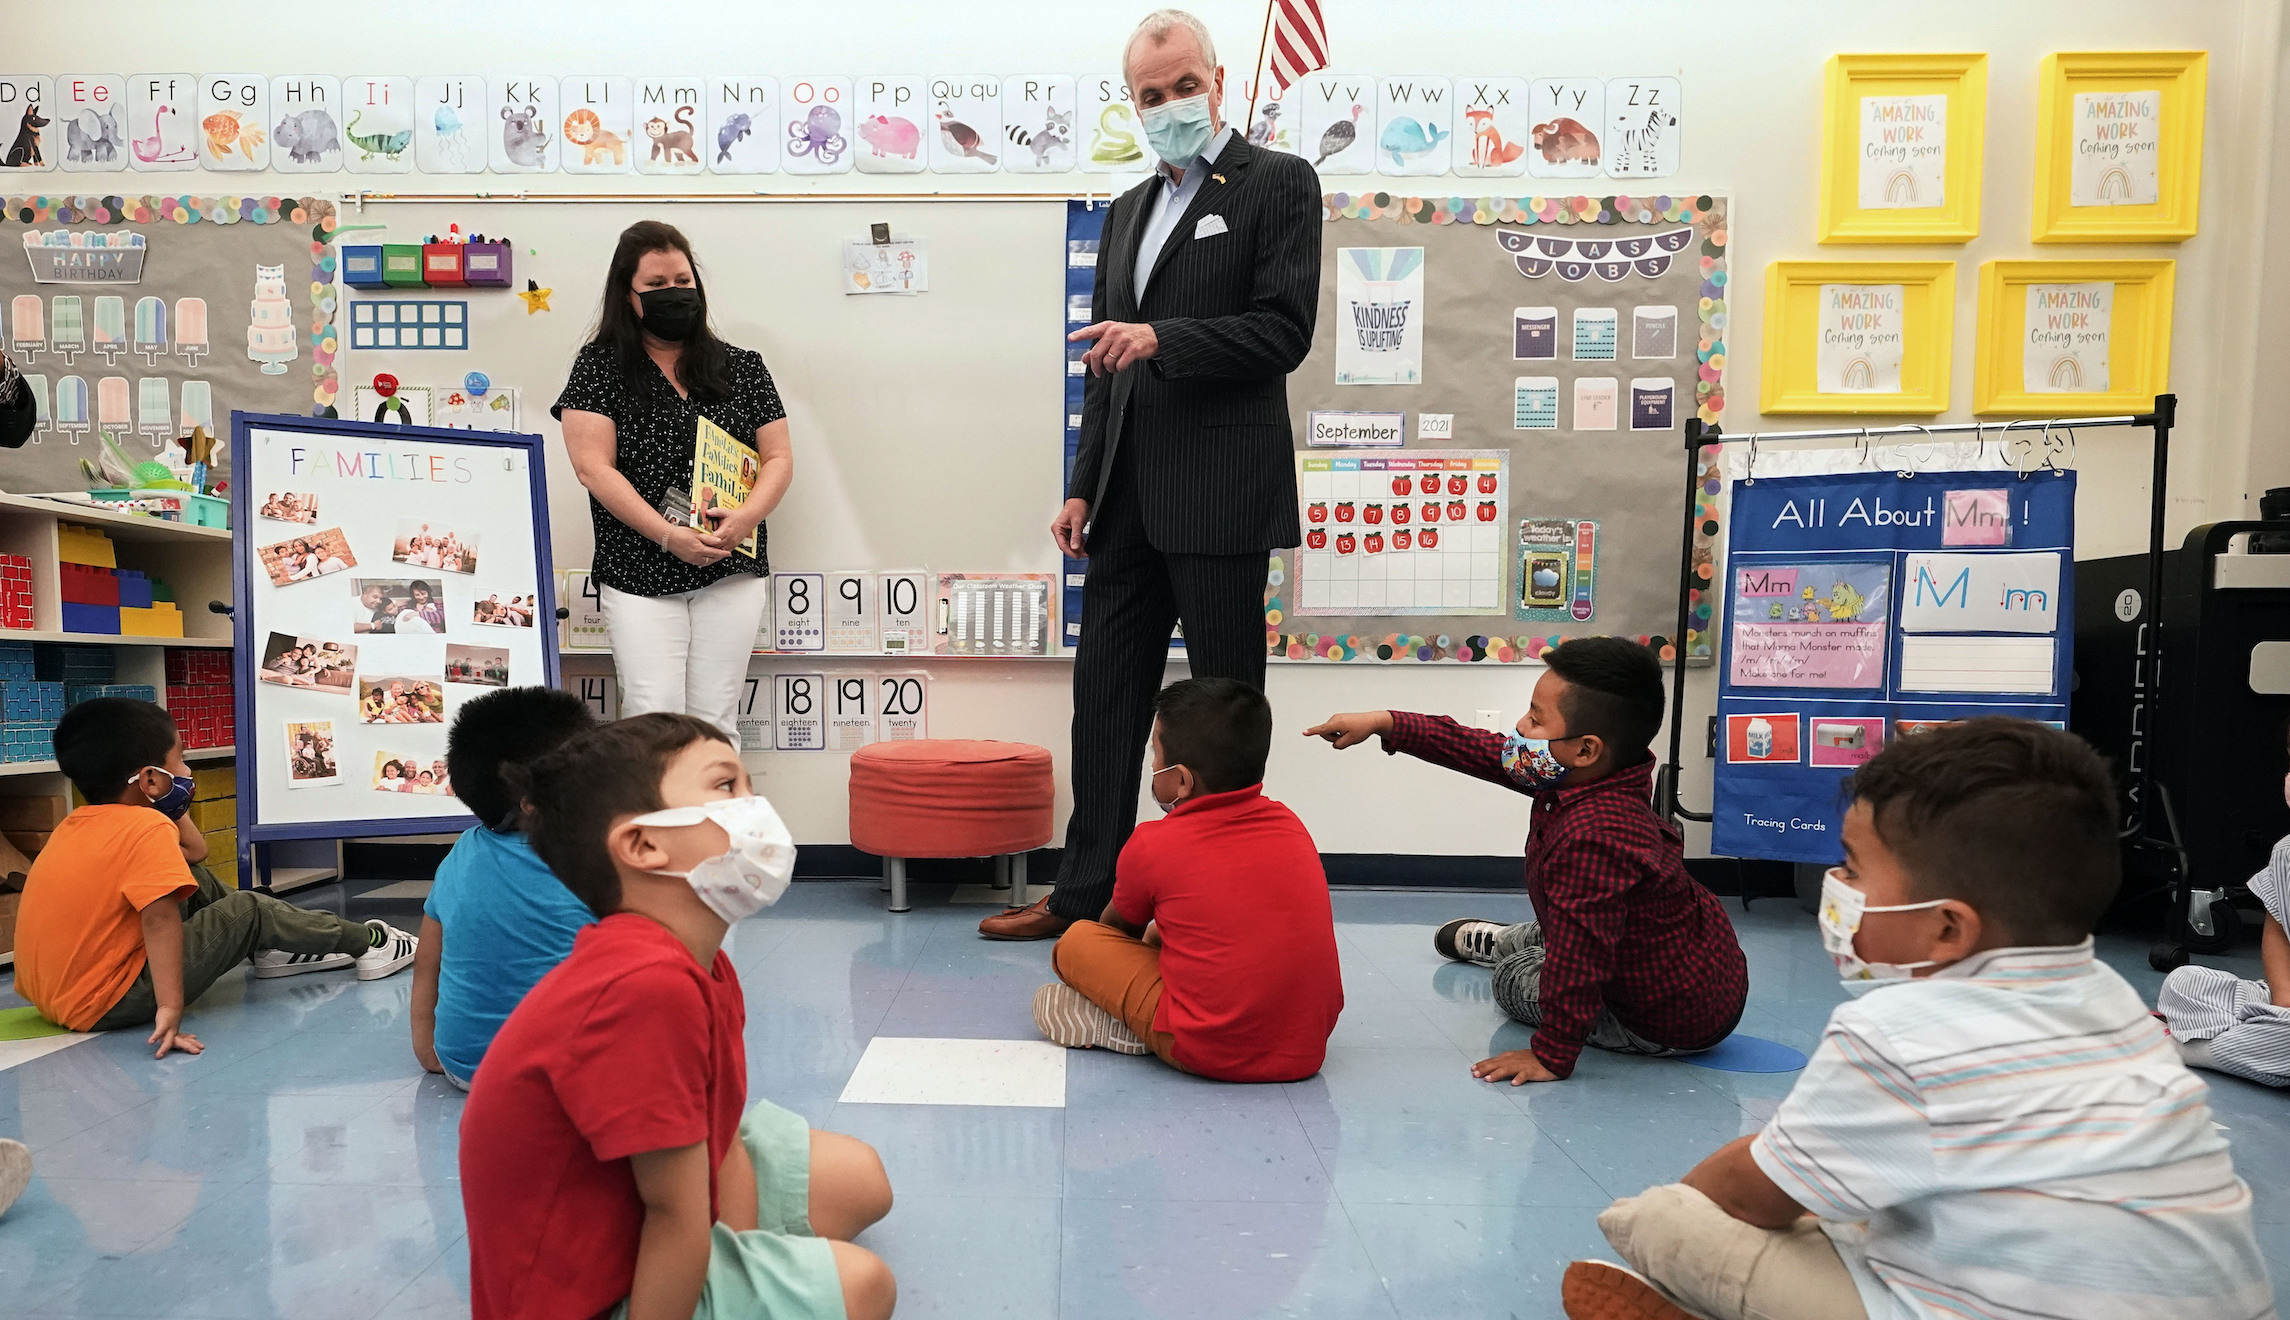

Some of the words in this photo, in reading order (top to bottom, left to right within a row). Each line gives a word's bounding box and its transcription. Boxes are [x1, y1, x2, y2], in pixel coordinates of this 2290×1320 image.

[1873, 104, 1935, 122] AMAZING
[2087, 99, 2149, 119] AMAZING
[1883, 126, 1924, 143] WORK
[2096, 122, 2138, 141] WORK
[1866, 142, 1906, 163] Coming
[1912, 145, 1941, 158] soon
[2080, 138, 2119, 160] Coming
[2125, 142, 2155, 154] soon
[1507, 235, 1680, 257] CLASS
[53, 252, 124, 267] HAPPY
[53, 267, 124, 280] BIRTHDAY
[1528, 259, 1659, 278] JOBS
[1832, 292, 1894, 310] AMAZING
[2038, 291, 2100, 309] AMAZING
[1352, 305, 1409, 330] KINDNESS
[1841, 313, 1882, 331] WORK
[2048, 312, 2088, 330] WORK
[1357, 328, 1366, 346] IS
[1365, 329, 1404, 348] UPLIFTING
[1824, 328, 1864, 350] Coming
[1870, 333, 1899, 344] soon
[2031, 328, 2071, 349] Coming
[2077, 332, 2106, 342] soon
[1422, 420, 1449, 432] 2021
[1316, 423, 1398, 442] September
[290, 447, 472, 484] FAMILIES
[1307, 461, 1328, 469] Sunday
[1335, 461, 1357, 469] Monday
[1363, 461, 1385, 469] Tuesday
[1388, 461, 1416, 469] Wednesday
[1418, 461, 1443, 469] Thursday
[1450, 461, 1467, 469] Friday
[1400, 482, 1404, 492] 1
[1426, 480, 1434, 490] 2
[1454, 481, 1461, 492] 3
[1483, 480, 1490, 490] 4
[1314, 509, 1321, 519] 5
[1341, 508, 1349, 519] 6
[1370, 511, 1377, 521] 7
[1397, 510, 1405, 520] 8
[1427, 508, 1434, 518] 9
[1450, 507, 1462, 517] 10
[1483, 508, 1490, 518] 11
[1771, 498, 1825, 529] All
[1838, 496, 1936, 528] About
[1946, 498, 2005, 528] Mm
[1530, 526, 1564, 535] Today's
[1312, 535, 1322, 546] 12
[1397, 535, 1406, 546] 15
[1422, 534, 1433, 544] 16
[1523, 533, 1562, 542] weather
[1341, 540, 1351, 551] 13
[1369, 539, 1379, 549] 14
[1744, 573, 1791, 595] Mm
[582, 576, 601, 613] 4
[788, 578, 810, 615] 8
[840, 578, 861, 615] 9
[887, 578, 917, 615] 10
[1534, 590, 1556, 598] cloudy
[2123, 594, 2133, 616] 20
[584, 615, 601, 624] four
[788, 618, 810, 628] eight
[842, 618, 860, 627] nine
[895, 618, 910, 627] ten
[1742, 627, 1788, 638] Monsters
[1791, 627, 1822, 637] munch
[1840, 627, 1878, 638] muffins
[1742, 641, 1760, 651] that
[1763, 641, 1796, 651] Mama
[1800, 641, 1842, 651] Monster
[1740, 668, 1767, 678] Make
[1791, 668, 1806, 679] for
[1809, 670, 1827, 679] me!
[582, 678, 605, 714] 14
[786, 679, 812, 715] 18
[837, 679, 865, 715] 19
[882, 679, 923, 715] 20
[781, 718, 818, 729] eighteen
[833, 718, 870, 727] nineteen
[888, 718, 917, 729] twenty
[1748, 732, 1763, 740] MILK
[1743, 813, 1786, 834] Tracing
[1790, 817, 1826, 832] Cards
